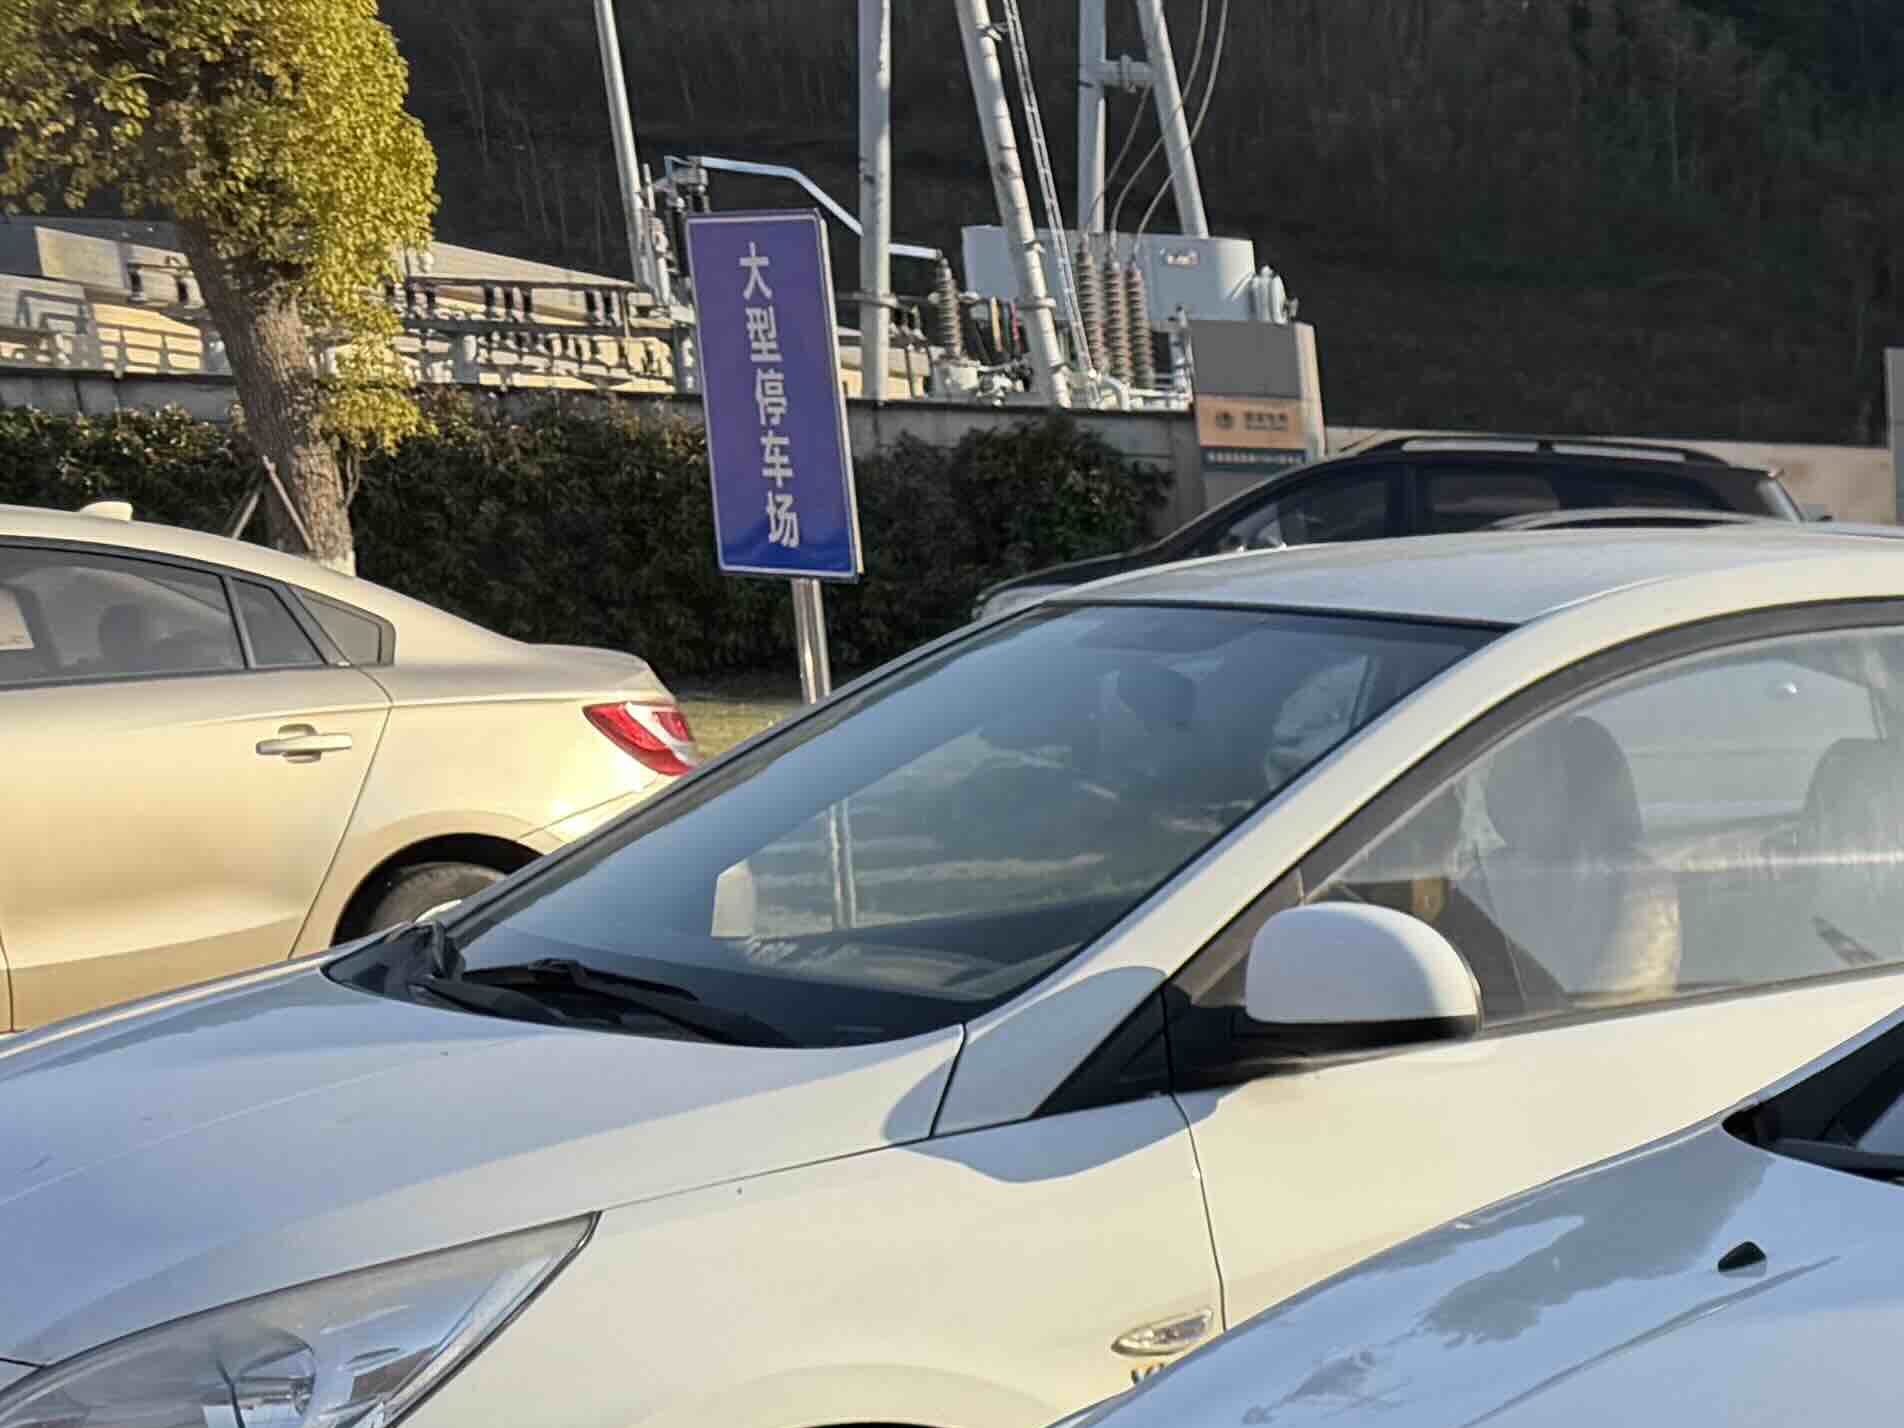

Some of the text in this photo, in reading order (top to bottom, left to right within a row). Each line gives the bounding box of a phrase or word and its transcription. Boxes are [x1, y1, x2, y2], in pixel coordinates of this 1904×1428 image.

[739, 241, 801, 548] 大型停车场
